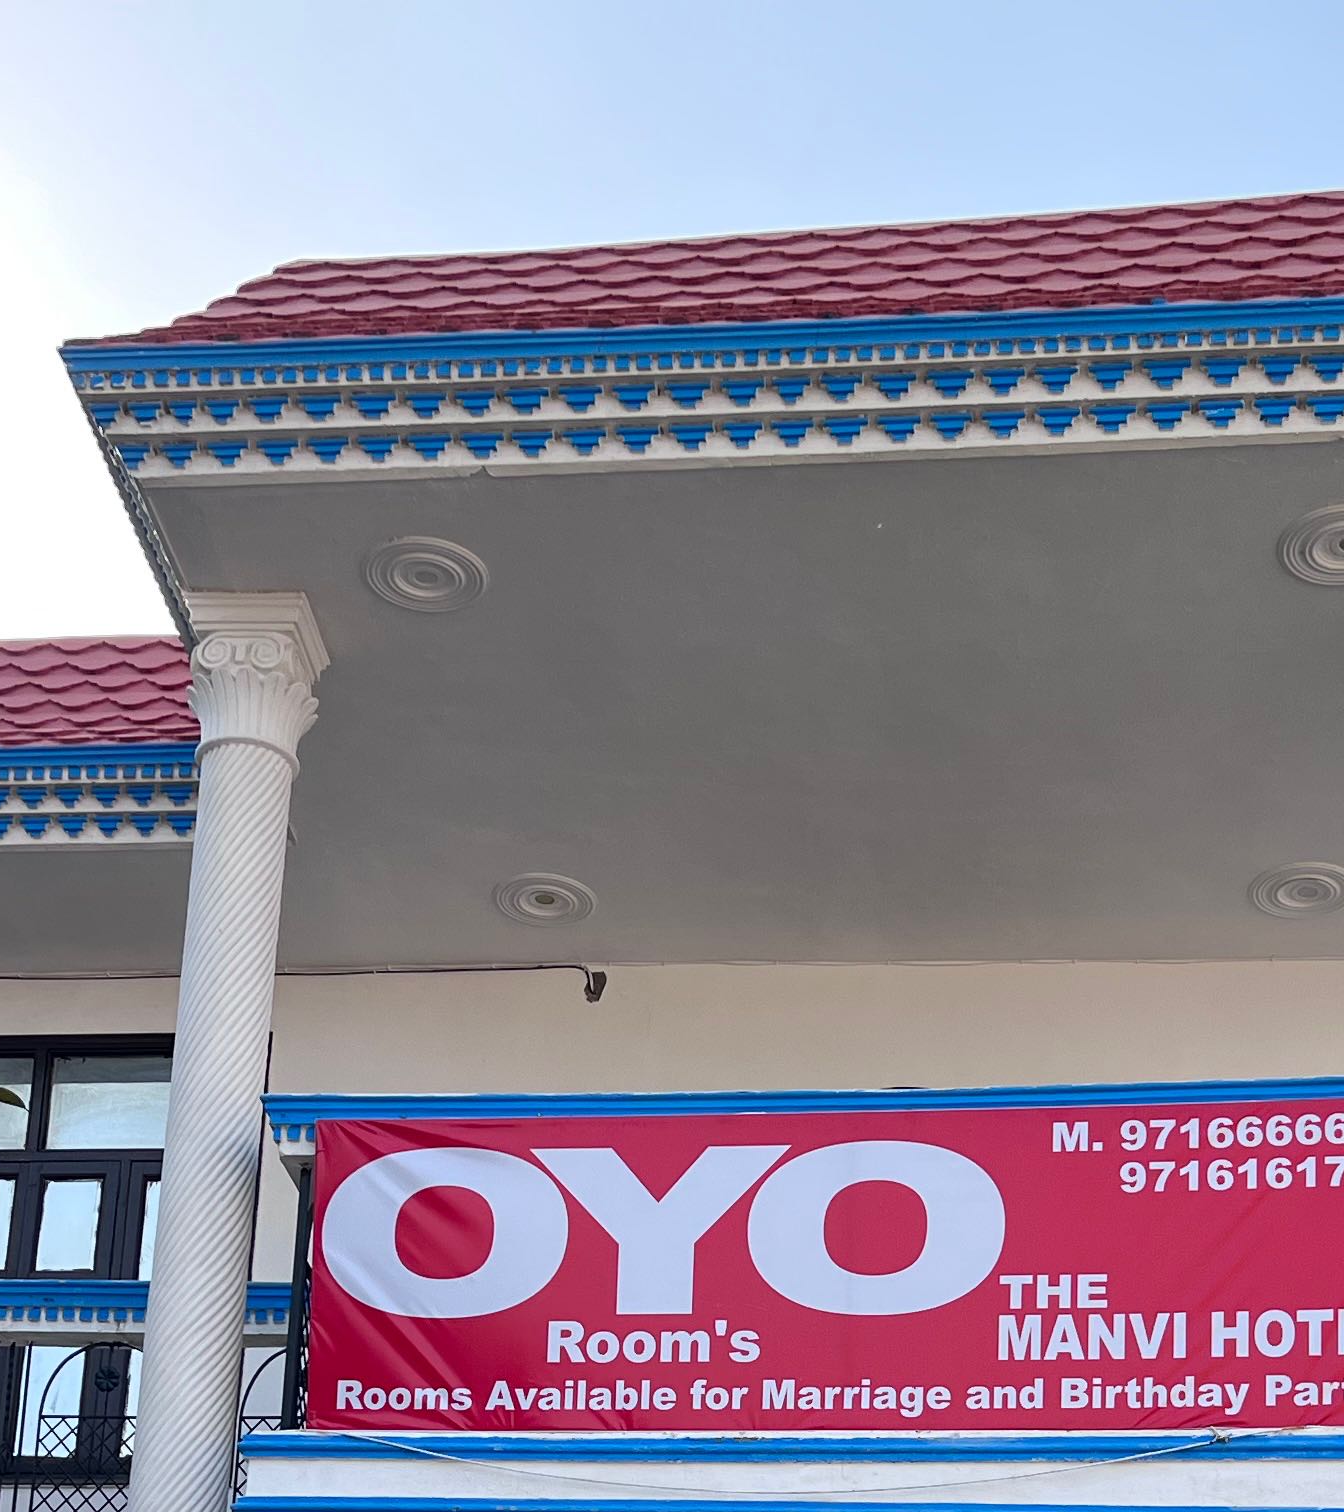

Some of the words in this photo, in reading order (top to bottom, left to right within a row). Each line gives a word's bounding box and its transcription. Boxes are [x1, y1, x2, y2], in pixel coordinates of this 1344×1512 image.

[1052, 1121, 1104, 1153] M.
[321, 1140, 1006, 1319] OYO
[999, 1273, 1109, 1310] THE
[546, 1319, 762, 1364] Room's
[997, 1311, 1188, 1361] MANVI
[336, 1379, 474, 1411] Rooms
[484, 1379, 677, 1411] Available
[689, 1379, 750, 1411] for
[761, 1379, 952, 1418] Marriage
[965, 1377, 1044, 1410] and
[1060, 1375, 1250, 1416] Birthday
